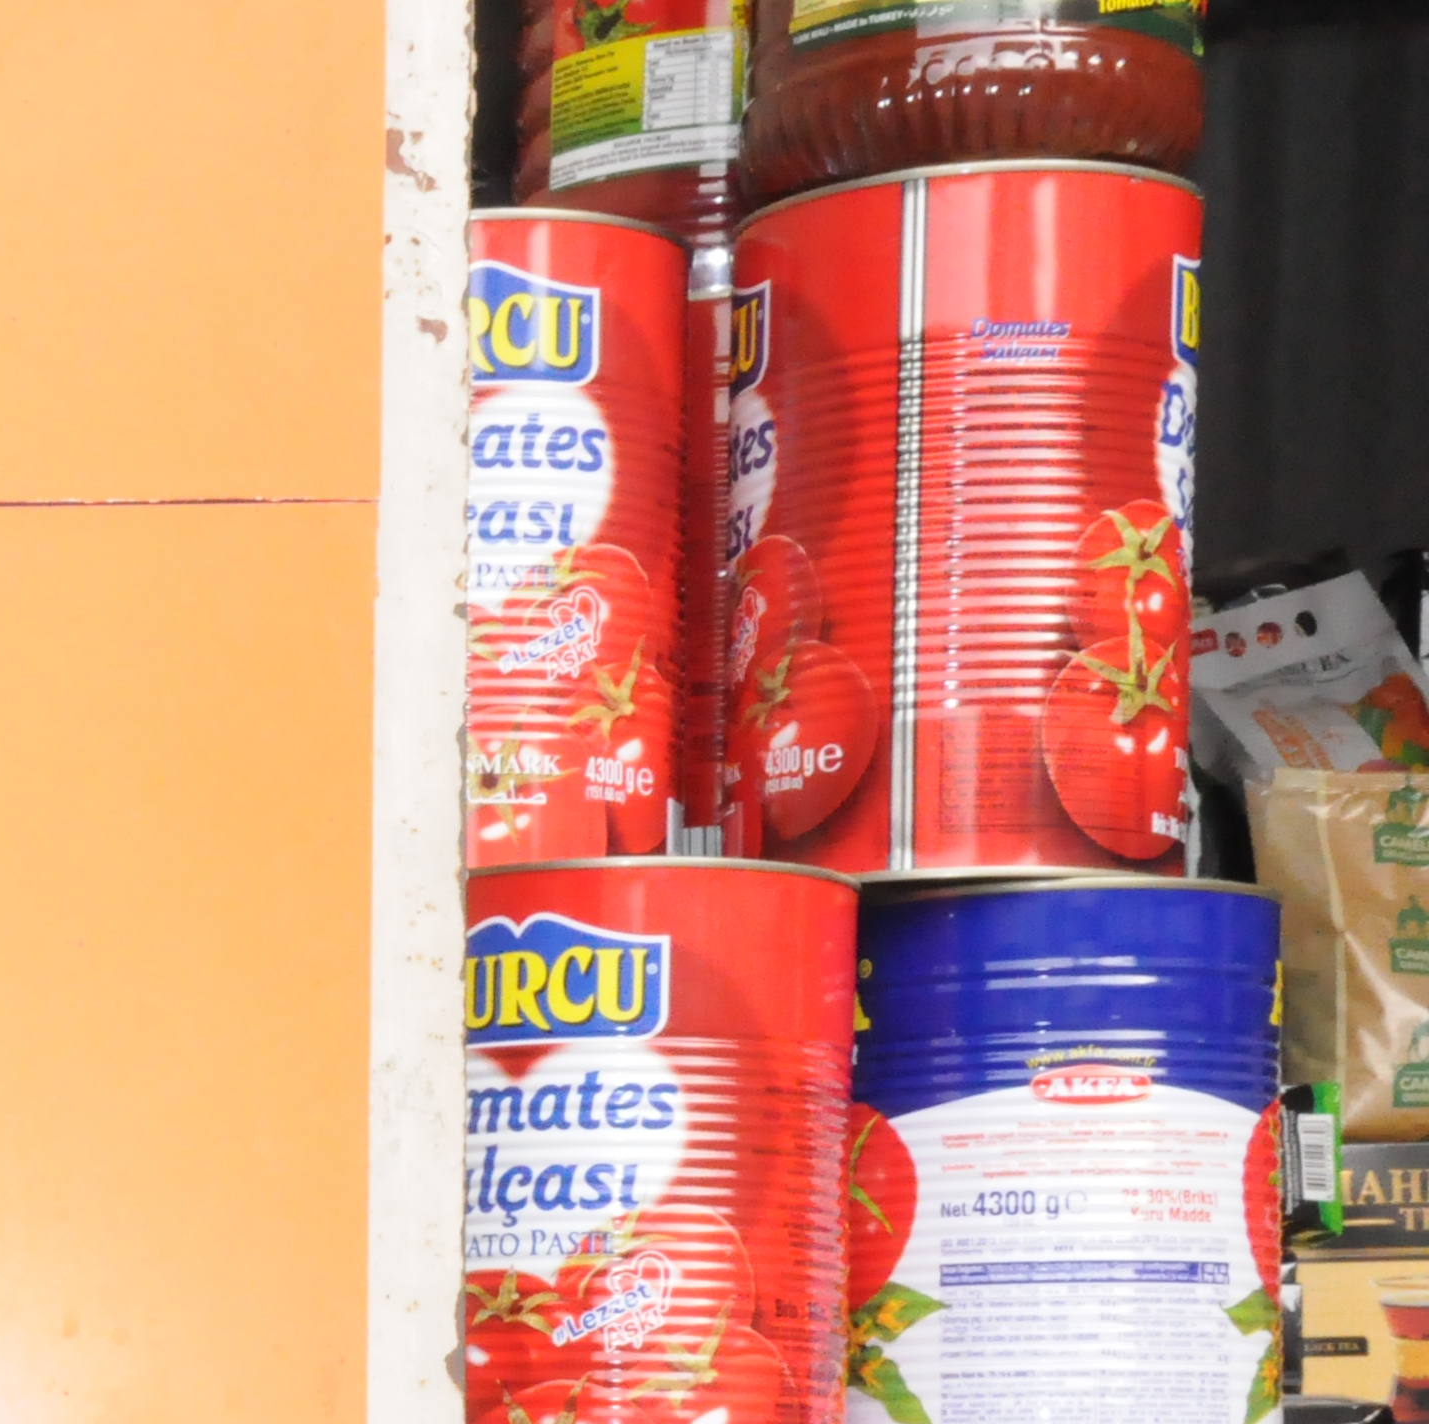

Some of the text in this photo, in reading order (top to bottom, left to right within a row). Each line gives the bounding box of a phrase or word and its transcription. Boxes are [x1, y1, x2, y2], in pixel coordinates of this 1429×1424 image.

[971, 317, 1071, 340] Domates
[585, 756, 624, 788] 4300
[972, 1190, 1036, 1217] 4300
